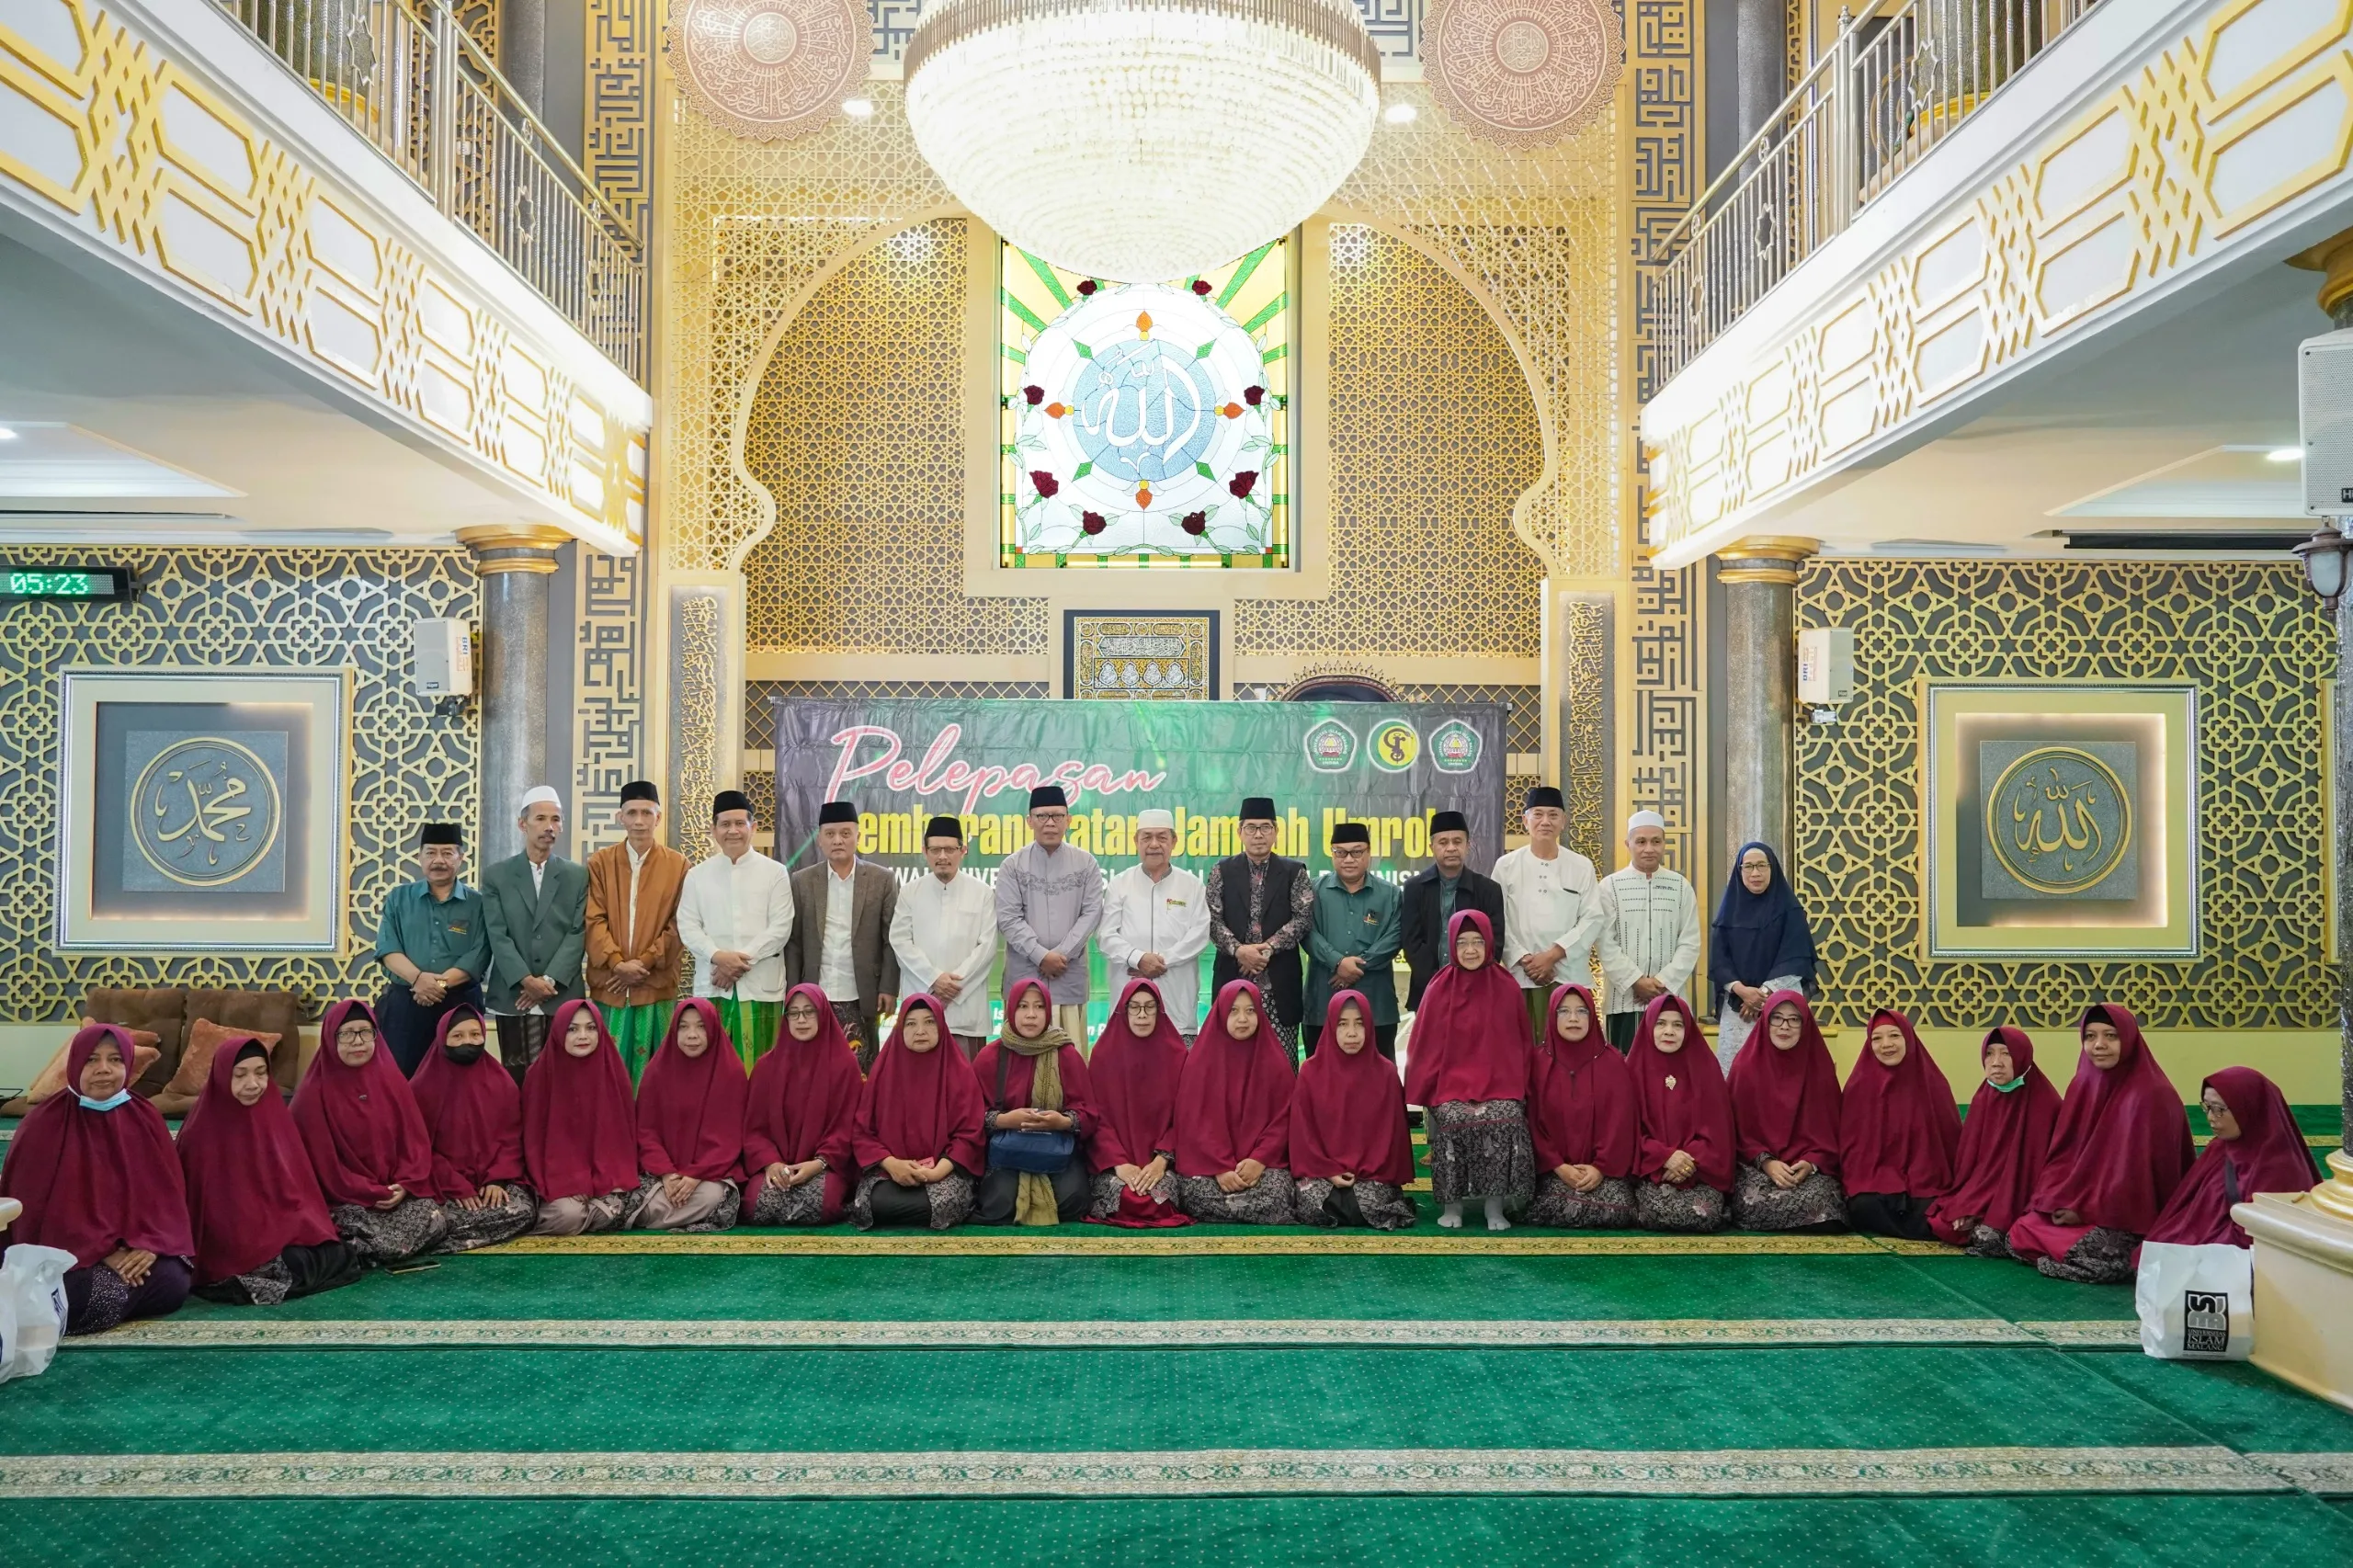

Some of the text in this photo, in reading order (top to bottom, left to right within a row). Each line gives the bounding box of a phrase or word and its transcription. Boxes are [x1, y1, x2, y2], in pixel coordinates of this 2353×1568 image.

[10, 573, 88, 594] 05:23
[824, 722, 1167, 821] Pelepasan
[2188, 1335, 2224, 1346] ISLAM
[2188, 1343, 2223, 1351] MALANG
